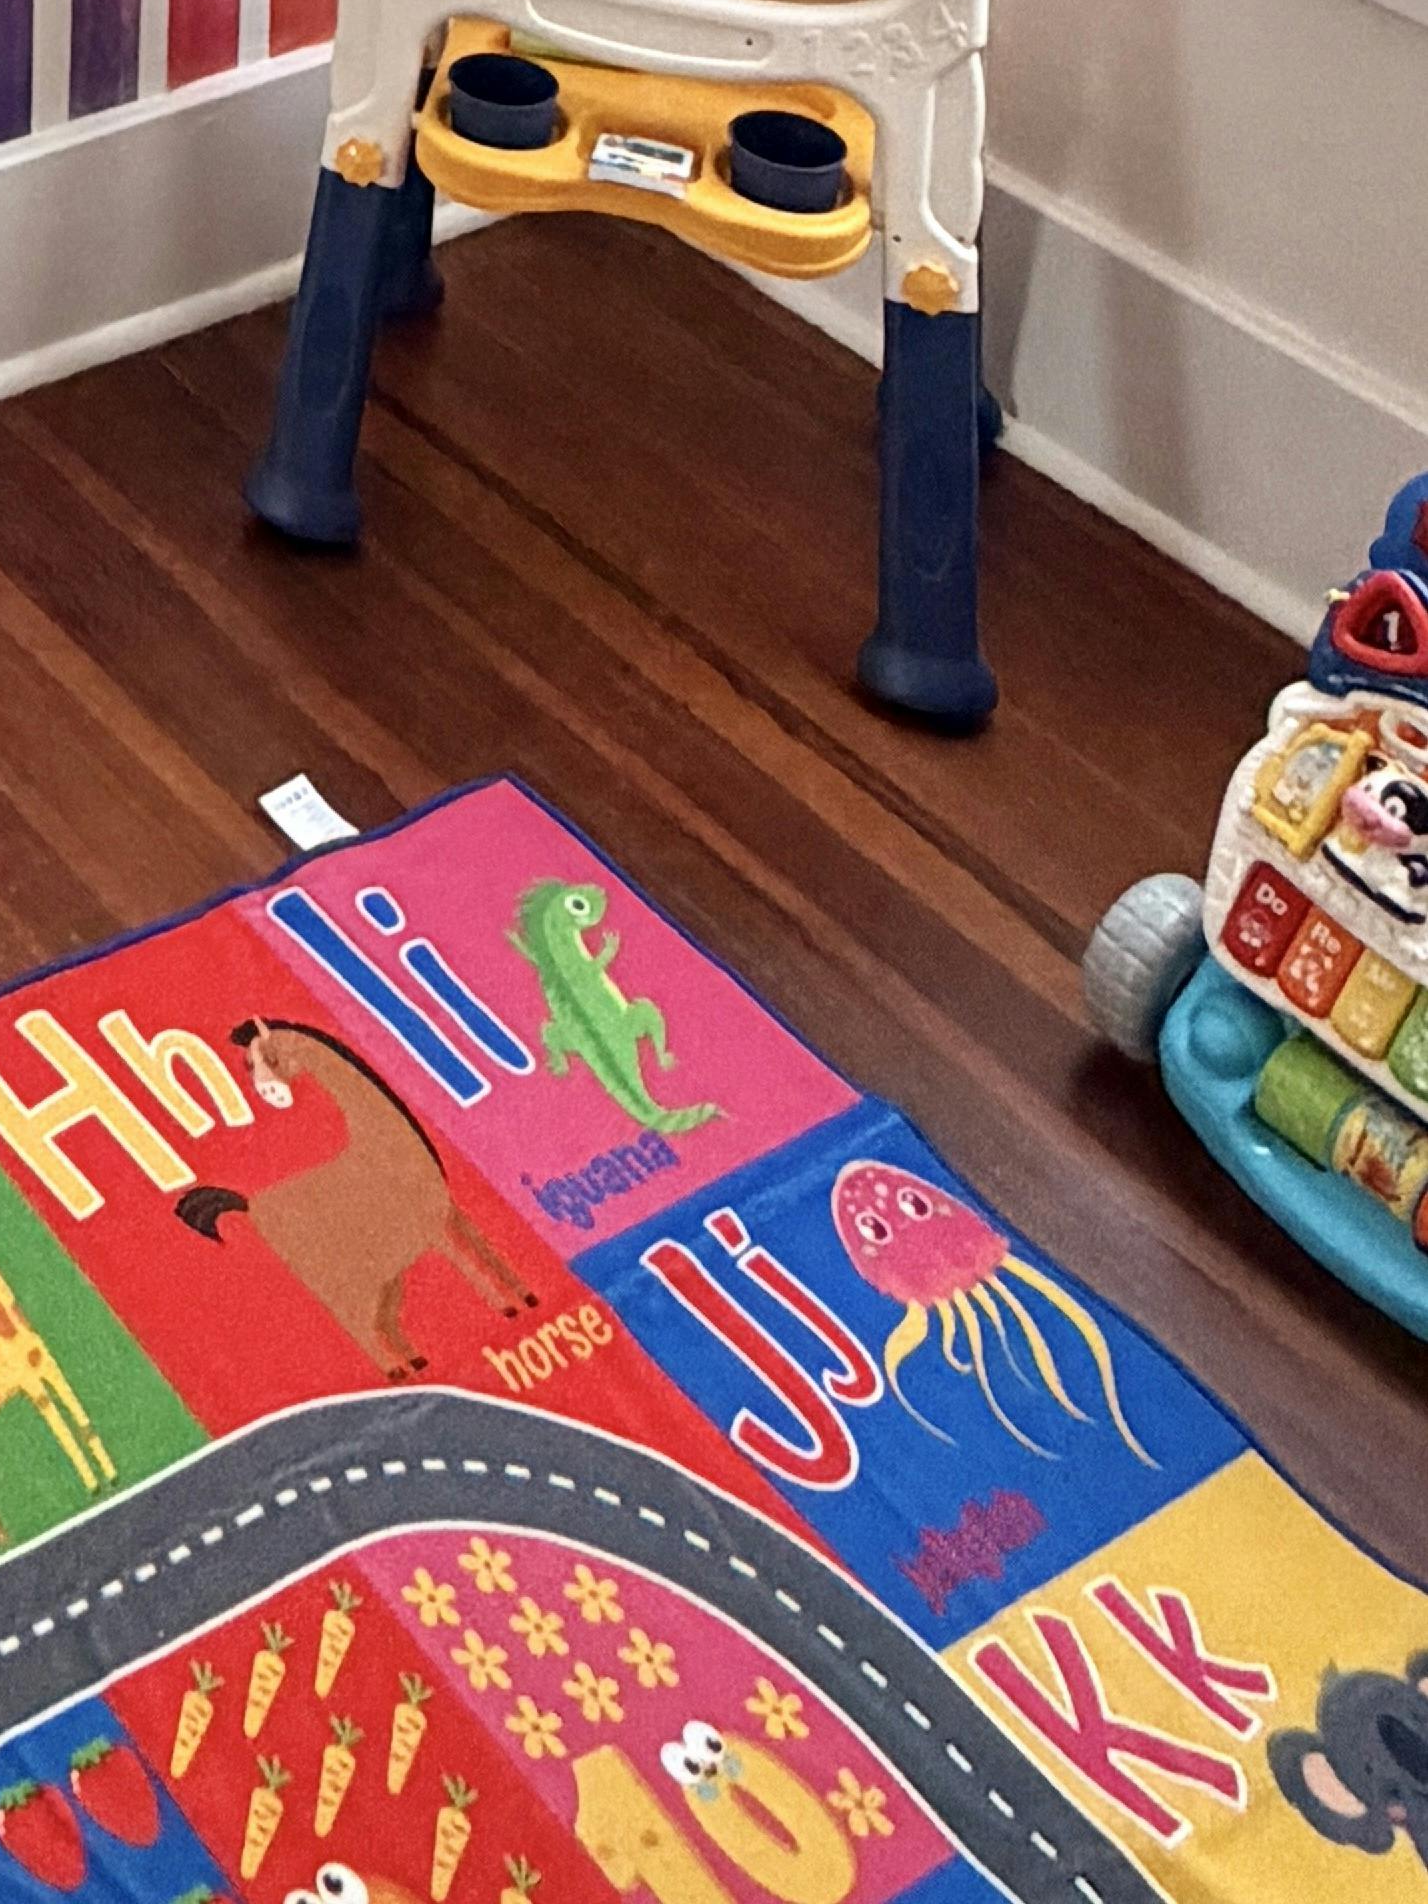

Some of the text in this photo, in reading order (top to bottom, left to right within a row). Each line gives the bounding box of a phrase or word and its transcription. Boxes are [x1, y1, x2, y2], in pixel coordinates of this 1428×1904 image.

[1383, 611, 1401, 651] 1
[267, 886, 534, 1107] Ii
[485, 1301, 614, 1391] horse
[642, 1209, 885, 1490] Jj
[969, 1574, 1276, 1847] Kk
